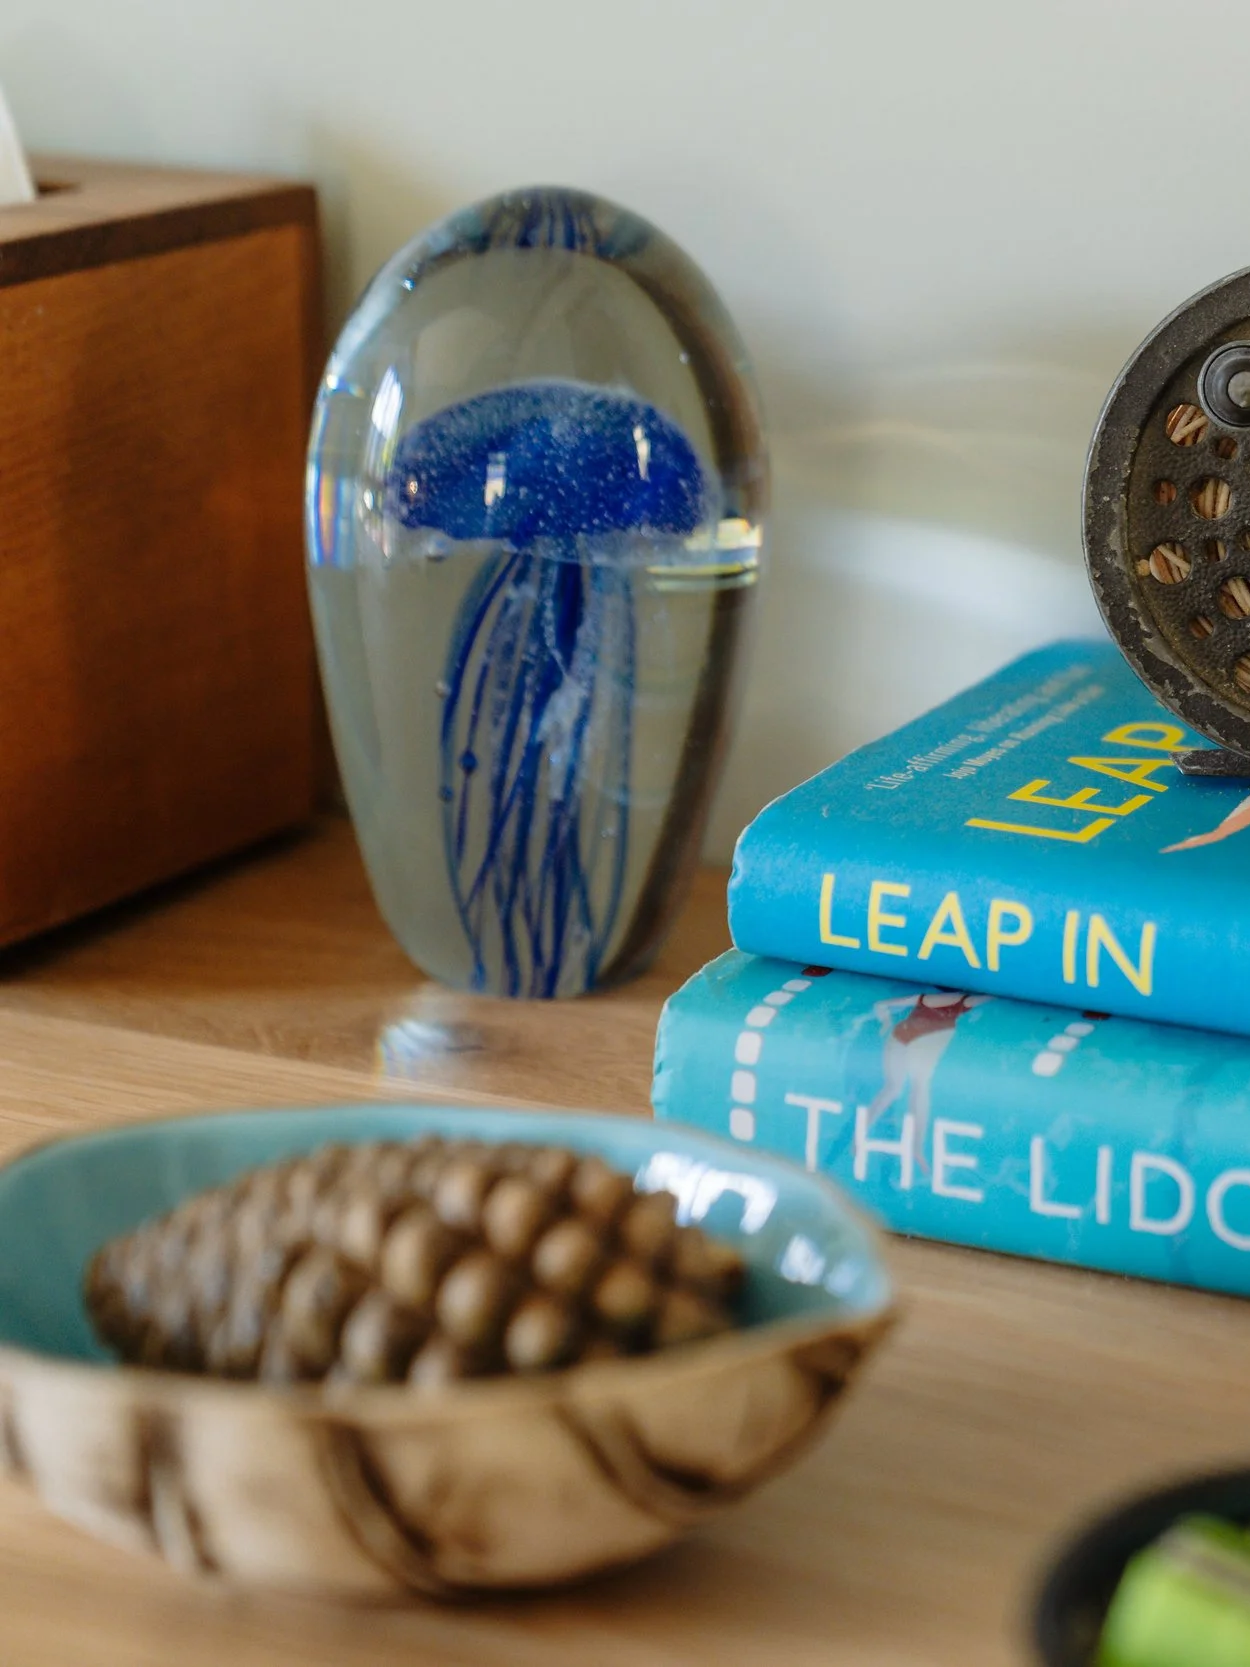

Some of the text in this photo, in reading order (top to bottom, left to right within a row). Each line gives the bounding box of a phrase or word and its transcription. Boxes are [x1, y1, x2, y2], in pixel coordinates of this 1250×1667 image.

[963, 721, 1202, 843] LEAP
[818, 873, 1157, 997] LEAP IN
[784, 1093, 985, 1202] THE
